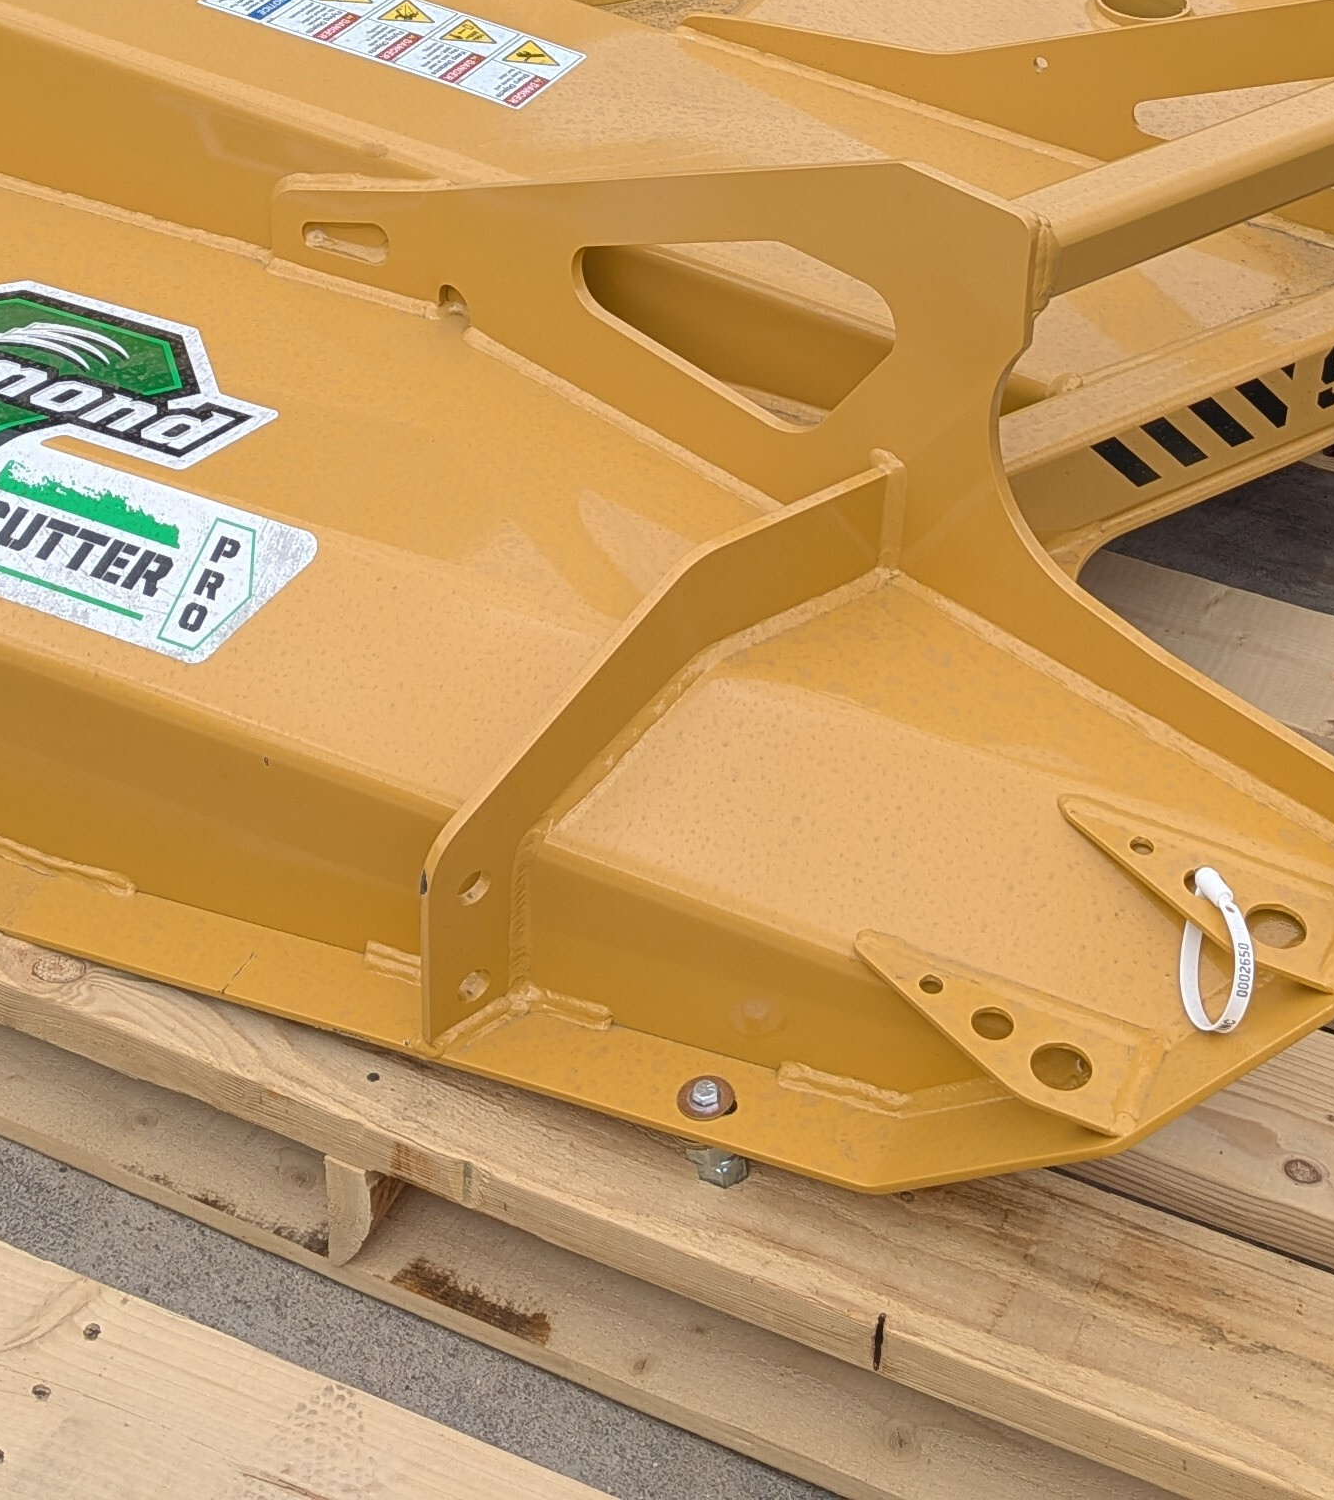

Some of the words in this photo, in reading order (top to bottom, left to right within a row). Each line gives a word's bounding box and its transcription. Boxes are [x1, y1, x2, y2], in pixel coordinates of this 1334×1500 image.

[315, 18, 352, 39] DANGER
[376, 37, 414, 60] DANGER
[441, 58, 477, 81] DANGER
[506, 81, 540, 104] DANGER
[178, 536, 240, 634] PRO
[1236, 942, 1250, 998] 0002650
